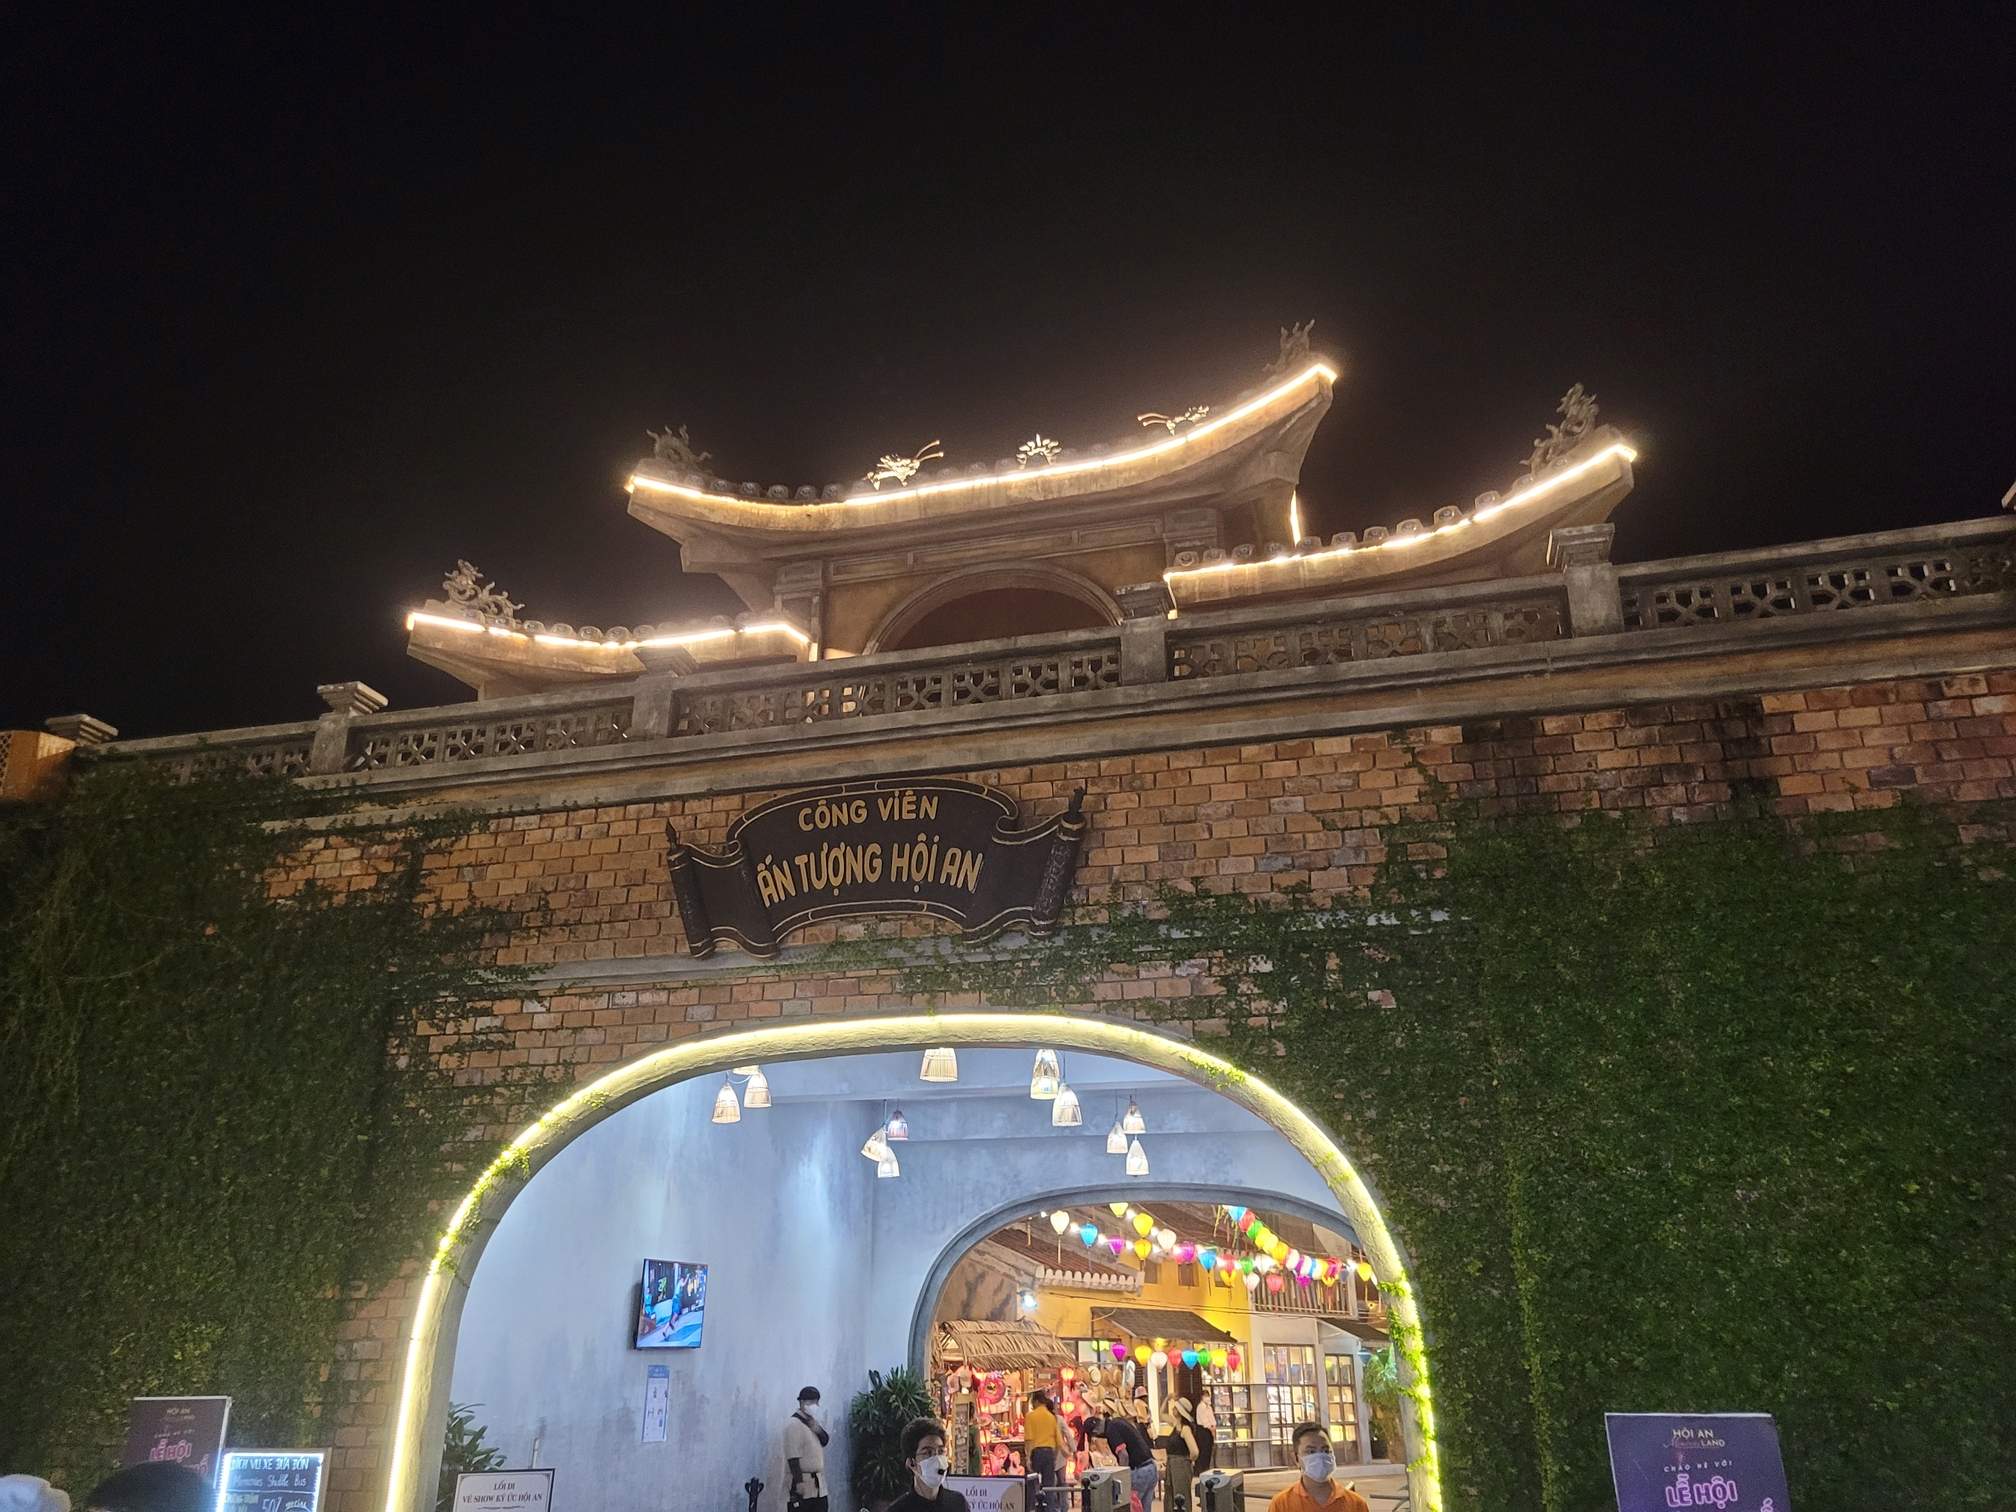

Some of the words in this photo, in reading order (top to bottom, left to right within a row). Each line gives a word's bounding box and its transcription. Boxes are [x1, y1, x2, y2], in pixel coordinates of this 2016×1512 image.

[798, 799, 868, 831] CÔNG
[879, 790, 939, 821] VIÊN
[757, 854, 796, 908] ẤN
[795, 841, 882, 896] TƯỢNG
[890, 833, 940, 893] HỘI
[941, 848, 985, 894] AN
[1697, 1429, 1714, 1439] AN
[1701, 1439, 1725, 1447] LAND
[1693, 1476, 1738, 1509] HỘI
